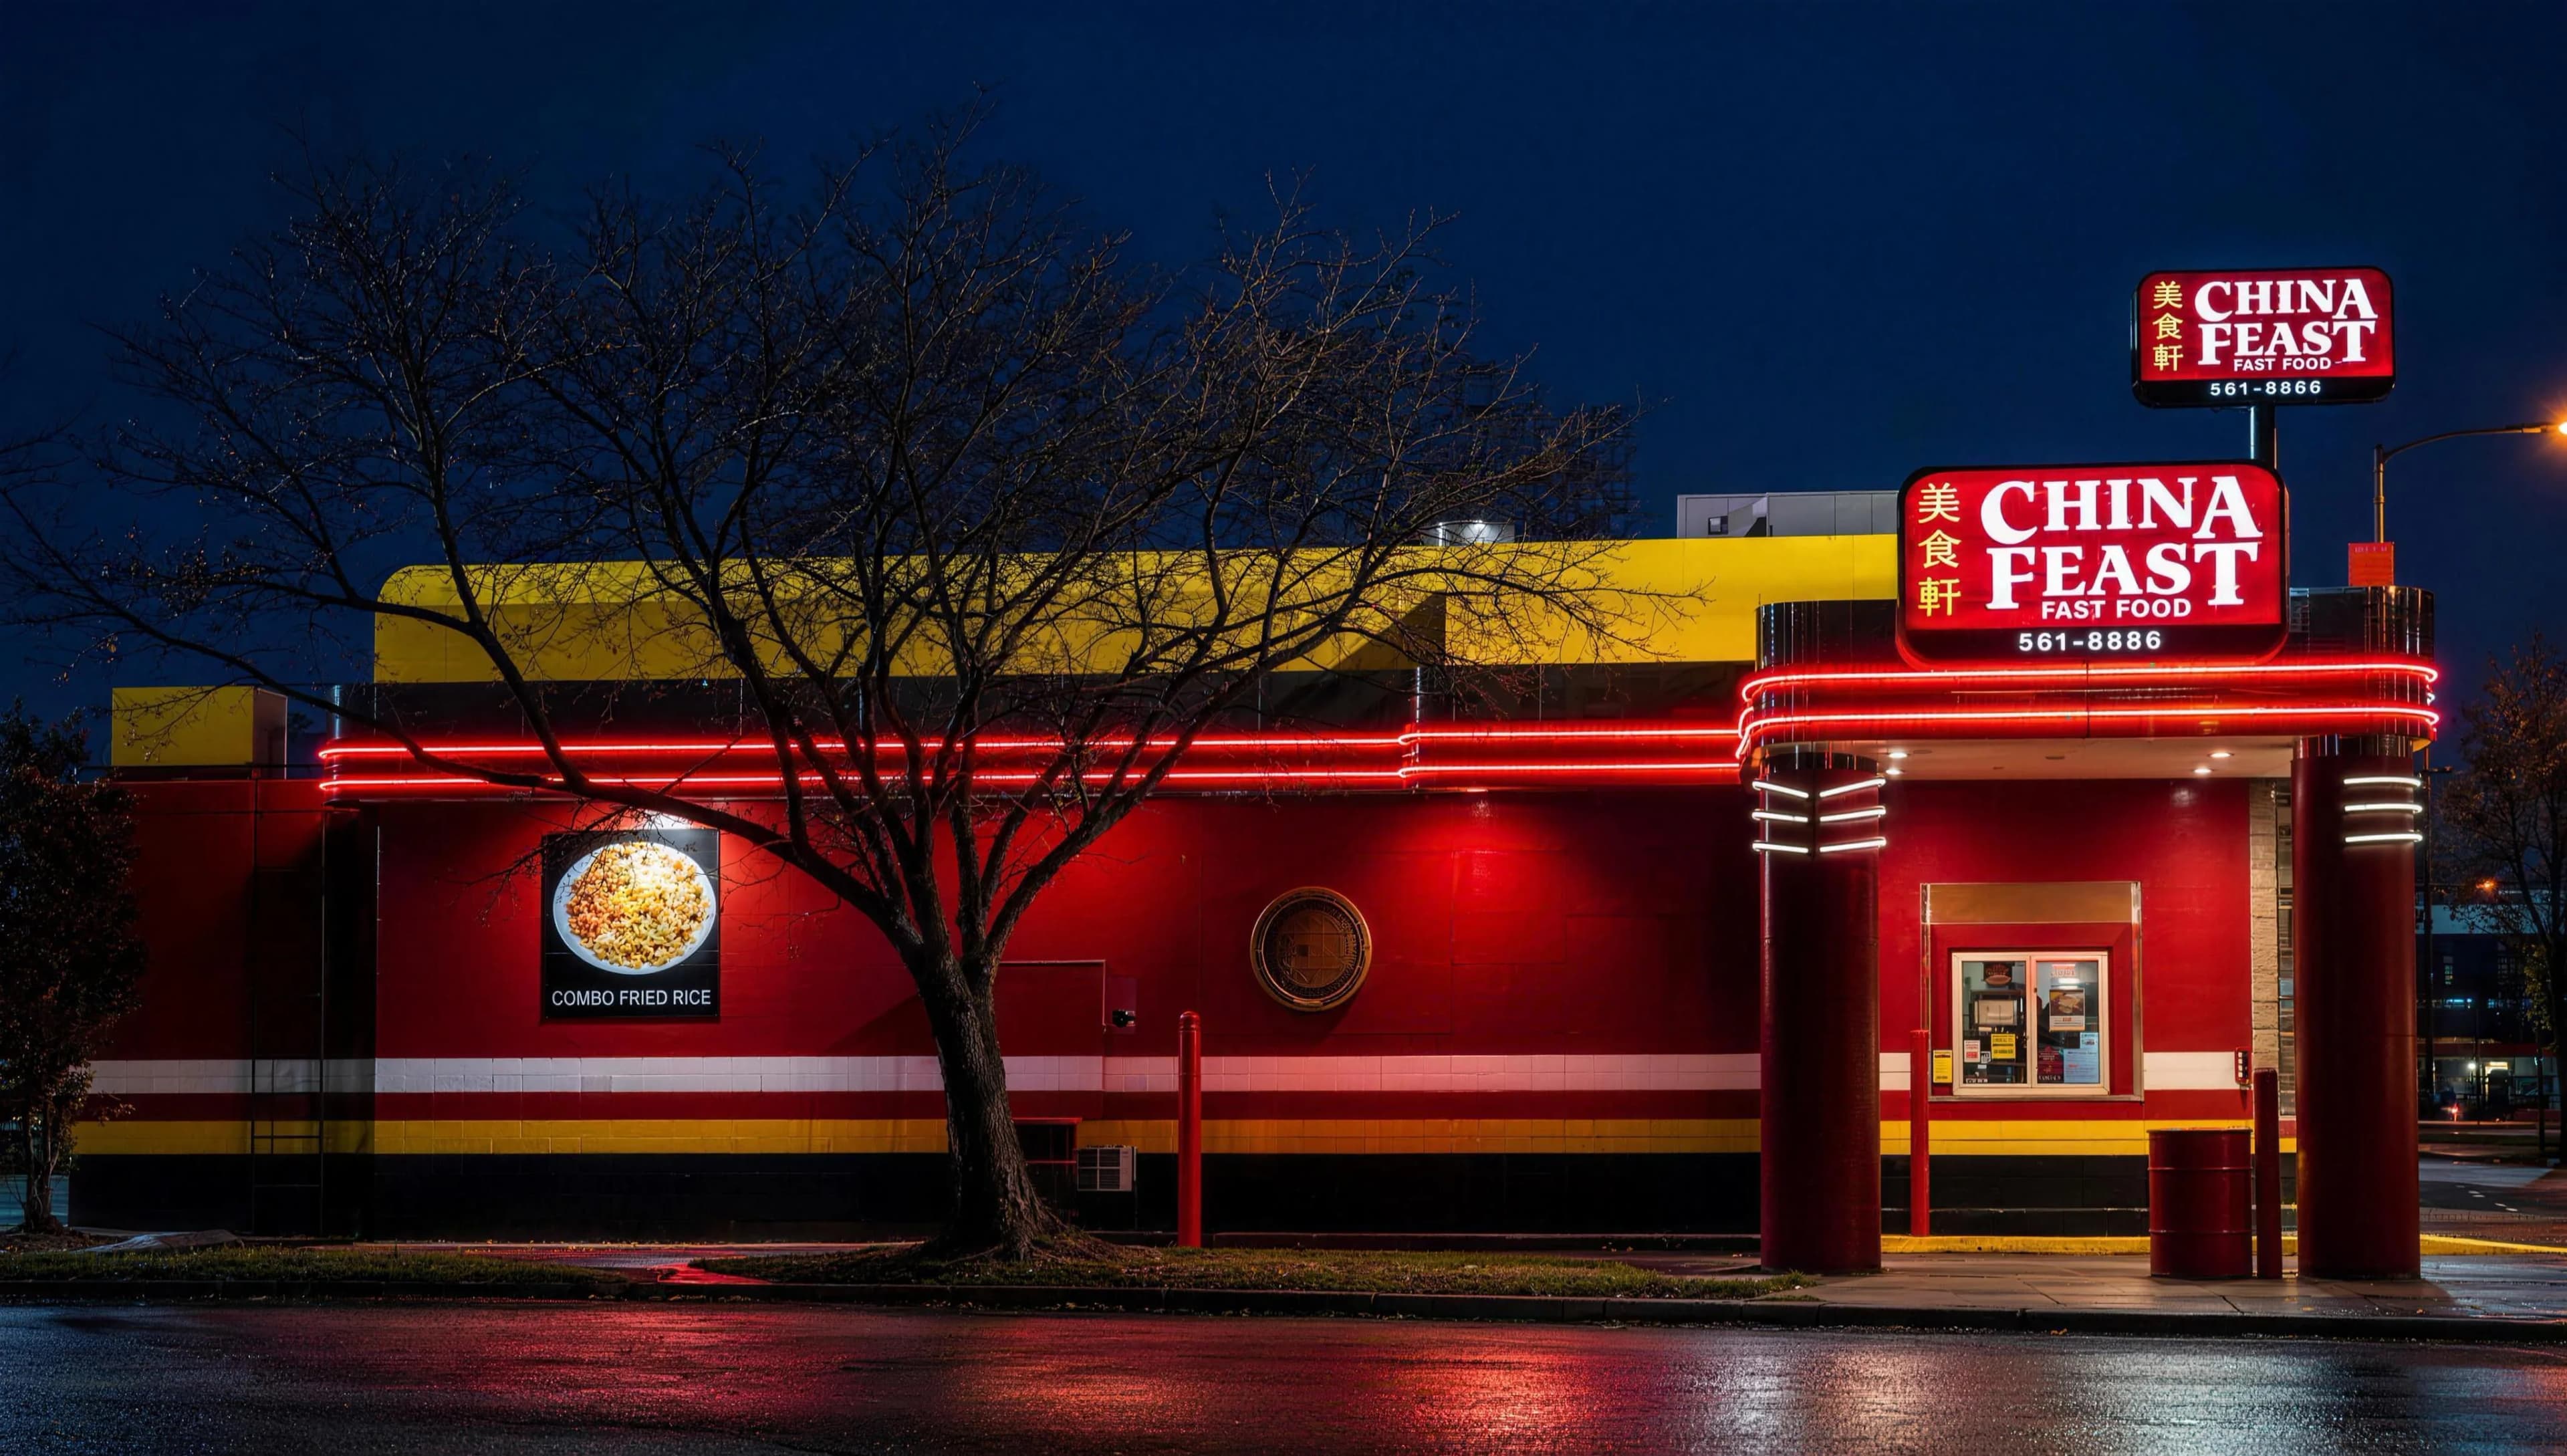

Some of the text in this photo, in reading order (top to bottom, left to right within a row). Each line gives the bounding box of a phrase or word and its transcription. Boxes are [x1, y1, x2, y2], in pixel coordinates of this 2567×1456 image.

[2195, 278, 2378, 322] CHINA
[2153, 280, 2184, 372] 美食軒
[2197, 320, 2376, 365] FEAST
[2233, 357, 2332, 372] FAST FOOD
[2209, 380, 2322, 396] 561-8866
[1981, 475, 2264, 545] CHINA
[1917, 481, 1962, 617] 美食軒
[1985, 541, 2259, 610] FEAST
[2041, 598, 2192, 620] FAST FOOD
[2018, 630, 2162, 652] 561-8886
[552, 989, 712, 1006] COMBO FRIED RICE
